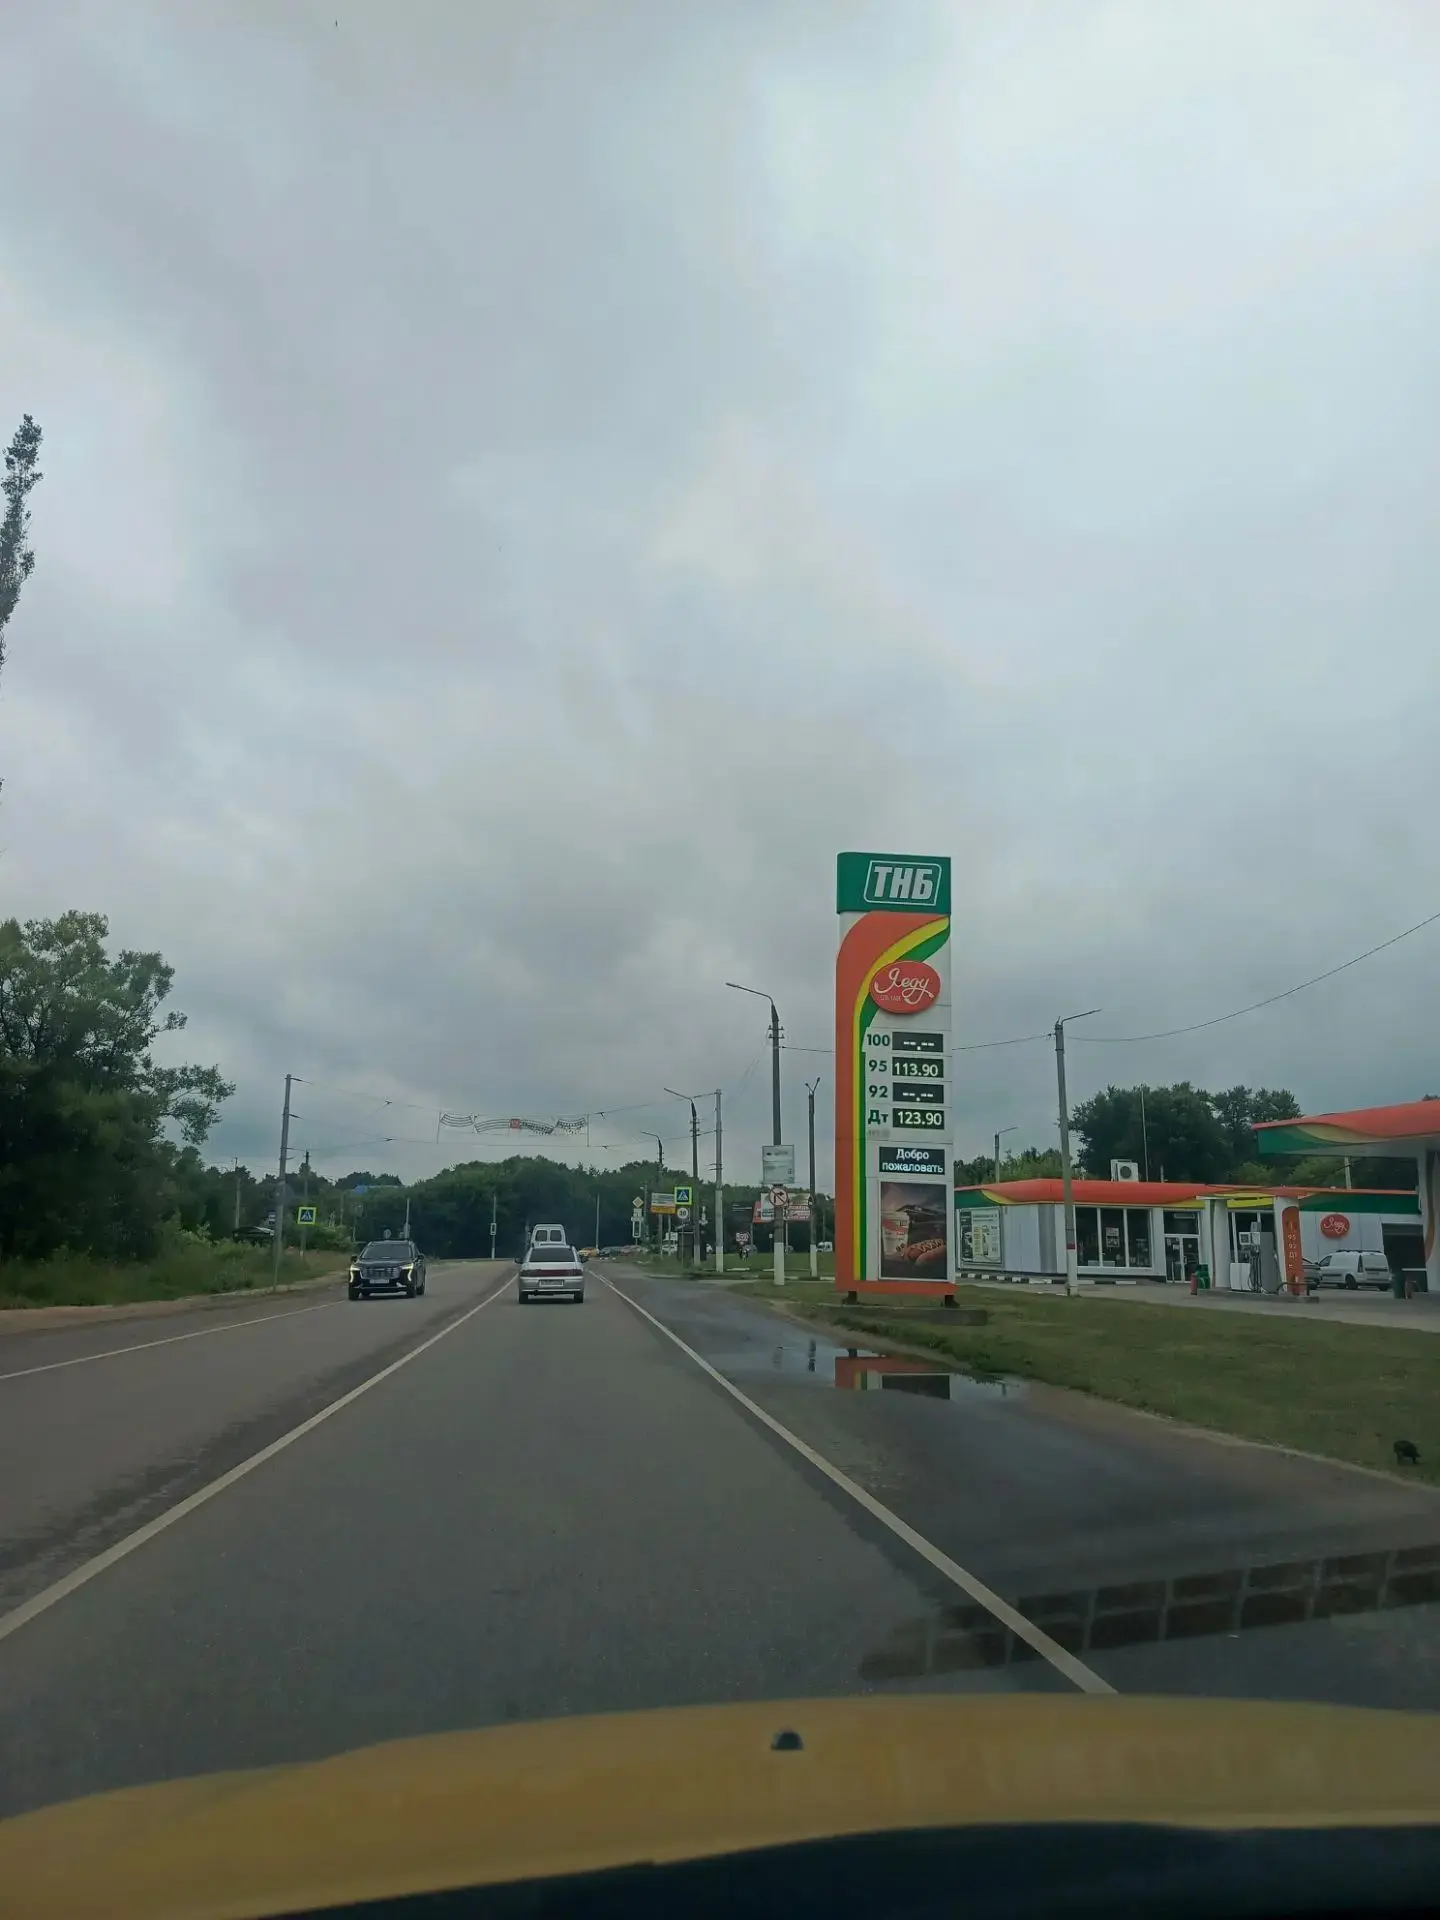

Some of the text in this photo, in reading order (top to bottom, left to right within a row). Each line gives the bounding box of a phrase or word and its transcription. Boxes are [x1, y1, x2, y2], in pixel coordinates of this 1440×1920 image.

[874, 866, 933, 900] ТНБ
[867, 1034, 890, 1047] 100
[868, 1060, 939, 1077] 95 113.90
[868, 1085, 888, 1098] 92
[897, 1110, 942, 1126] 123.90
[896, 1148, 930, 1161] Добро
[882, 1162, 944, 1173] пожаловать
